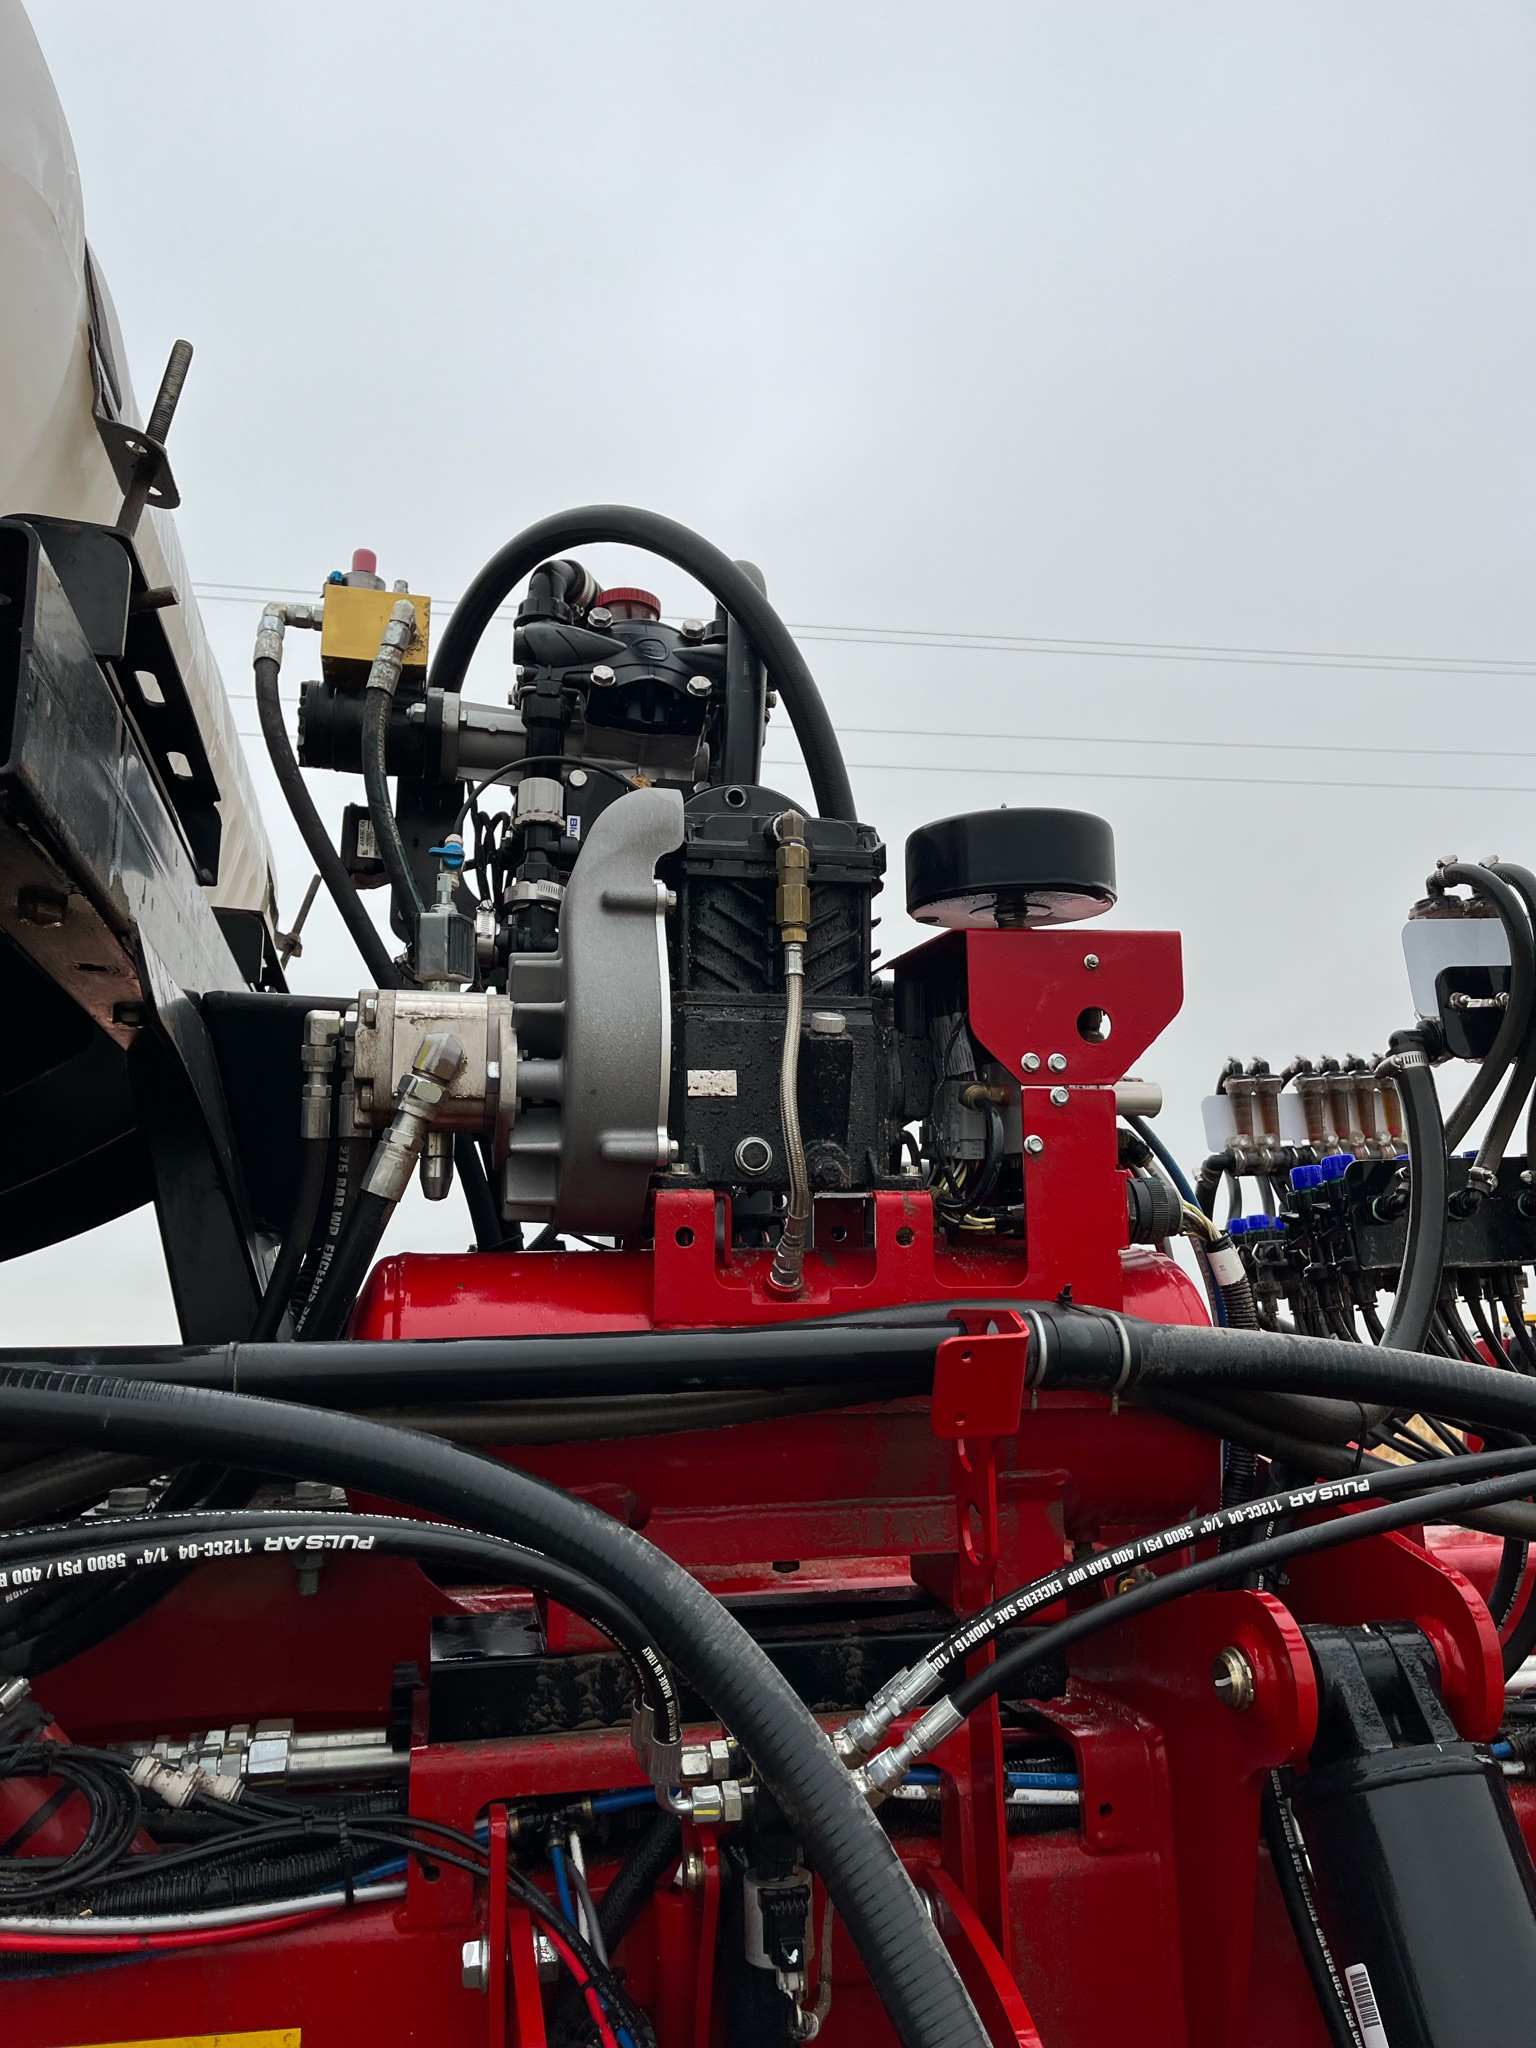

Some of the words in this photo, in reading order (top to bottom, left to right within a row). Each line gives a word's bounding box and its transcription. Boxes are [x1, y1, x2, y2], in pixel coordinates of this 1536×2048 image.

[338, 1146, 349, 1173] 275
[333, 1178, 348, 1207] BAR
[329, 1211, 342, 1236] WP
[1228, 1499, 1282, 1524] 112CC-04
[1200, 1514, 1224, 1534] 1/4"
[1143, 1536, 1164, 1554] PSI
[1164, 1525, 1194, 1546] 5800
[136, 1547, 169, 1565] 1/4"
[178, 1538, 252, 1560] 112CC-04
[1112, 1548, 1134, 1566] 400
[46, 1564, 54, 1580] /
[57, 1559, 82, 1578] PSI
[87, 1552, 126, 1572] 5800
[1086, 1556, 1112, 1576] BAR
[12, 1568, 42, 1585] 400
[1067, 1568, 1088, 1586] WP
[1016, 1579, 1064, 1612] EXCEEDS
[994, 1604, 1018, 1624] SAE
[954, 1618, 996, 1652] 100R16
[642, 1646, 659, 1666] ITALY
[653, 1664, 664, 1676] IN
[658, 1674, 672, 1699] MADE
[1280, 1808, 1296, 1850] 100R16
[1292, 1852, 1304, 1873] SAE
[1298, 1876, 1319, 1922] EXCEEDS
[1316, 1928, 1327, 1947] WP
[1323, 1950, 1336, 1973] BAR
[1332, 1976, 1346, 1998] 330
[1344, 2008, 1356, 2028] PSI
